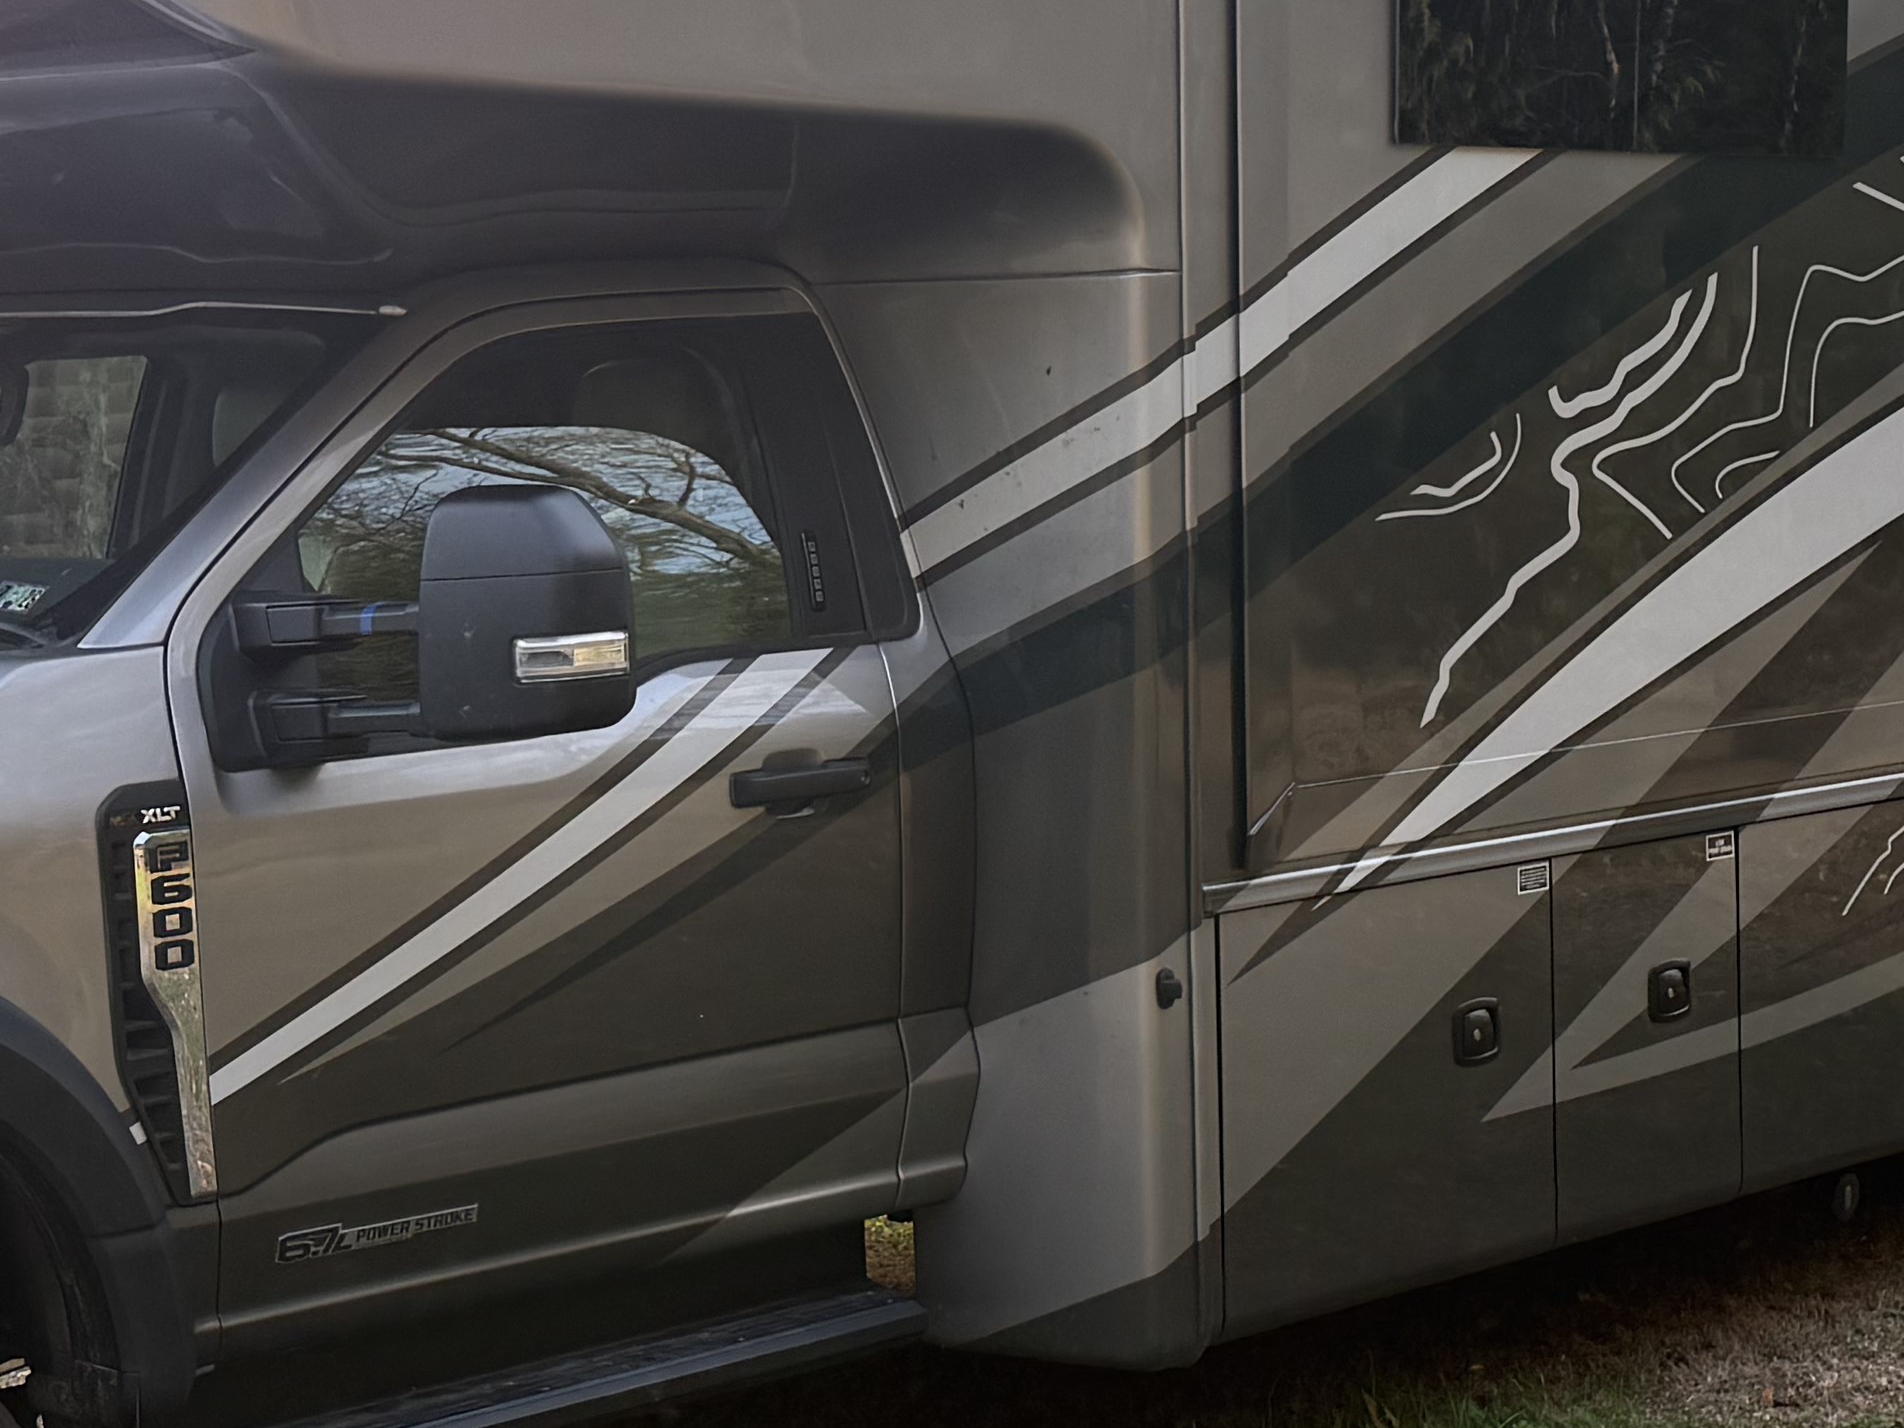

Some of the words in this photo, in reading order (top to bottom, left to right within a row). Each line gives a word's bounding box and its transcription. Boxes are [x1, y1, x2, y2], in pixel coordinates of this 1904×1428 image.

[141, 805, 181, 824] XLT
[149, 840, 195, 971] F600
[356, 1222, 412, 1242] POWER
[414, 1210, 475, 1231] STROKE
